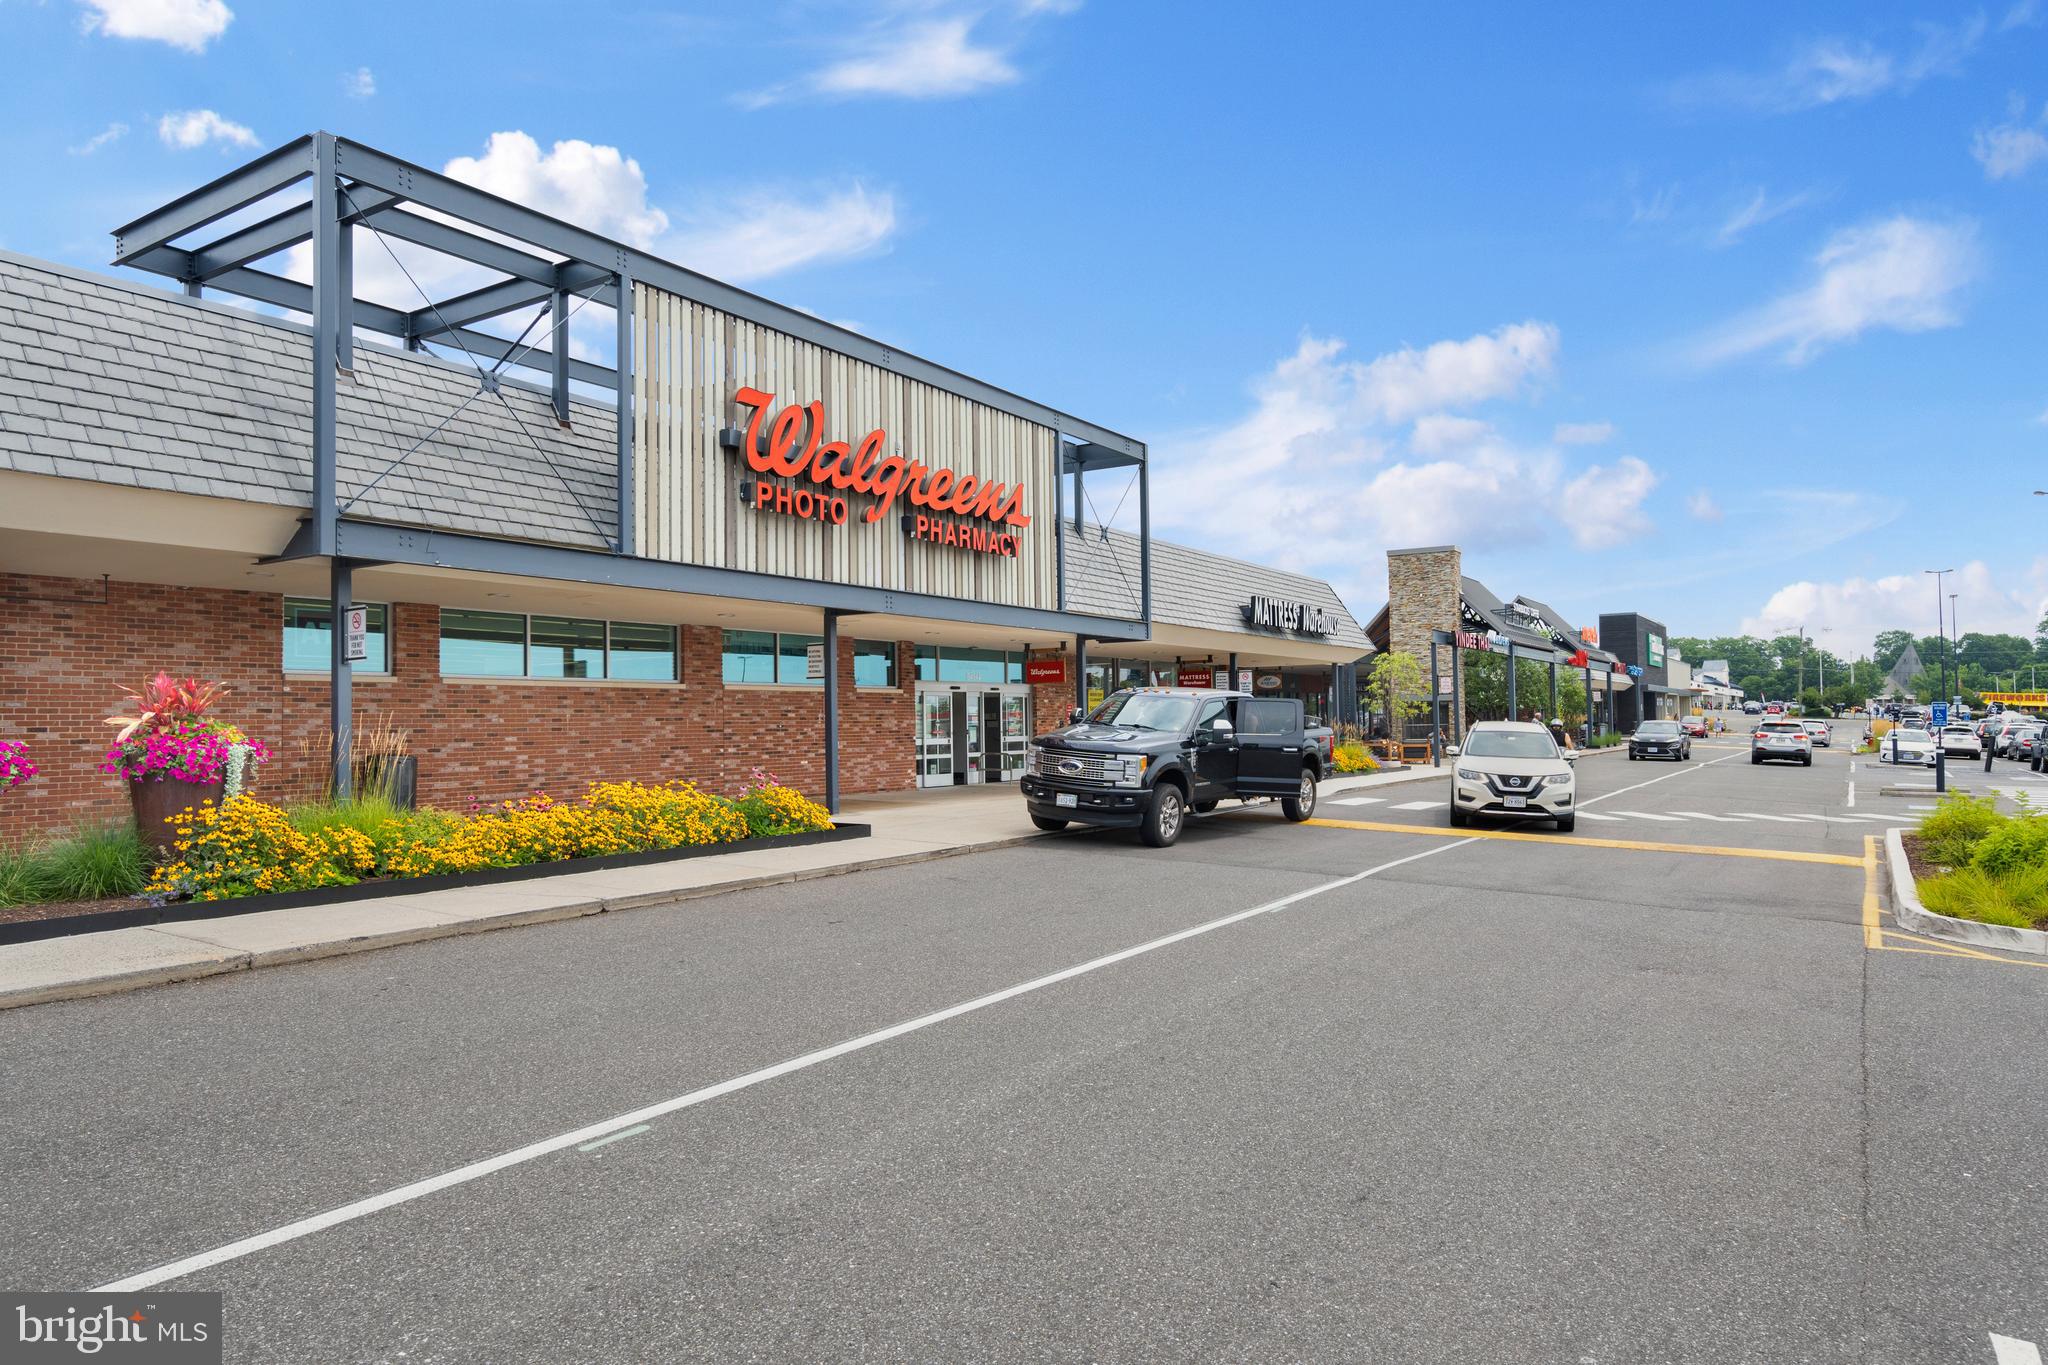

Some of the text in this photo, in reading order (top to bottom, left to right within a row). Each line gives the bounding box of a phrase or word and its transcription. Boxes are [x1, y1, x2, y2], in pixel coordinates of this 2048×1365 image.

[735, 386, 1031, 528] Walgreens
[756, 481, 848, 525] PHOTO
[916, 514, 1022, 558] PHARMACY
[1253, 595, 1340, 636] MATTRESS Warehouse
[1030, 668, 1060, 677] Walgreens
